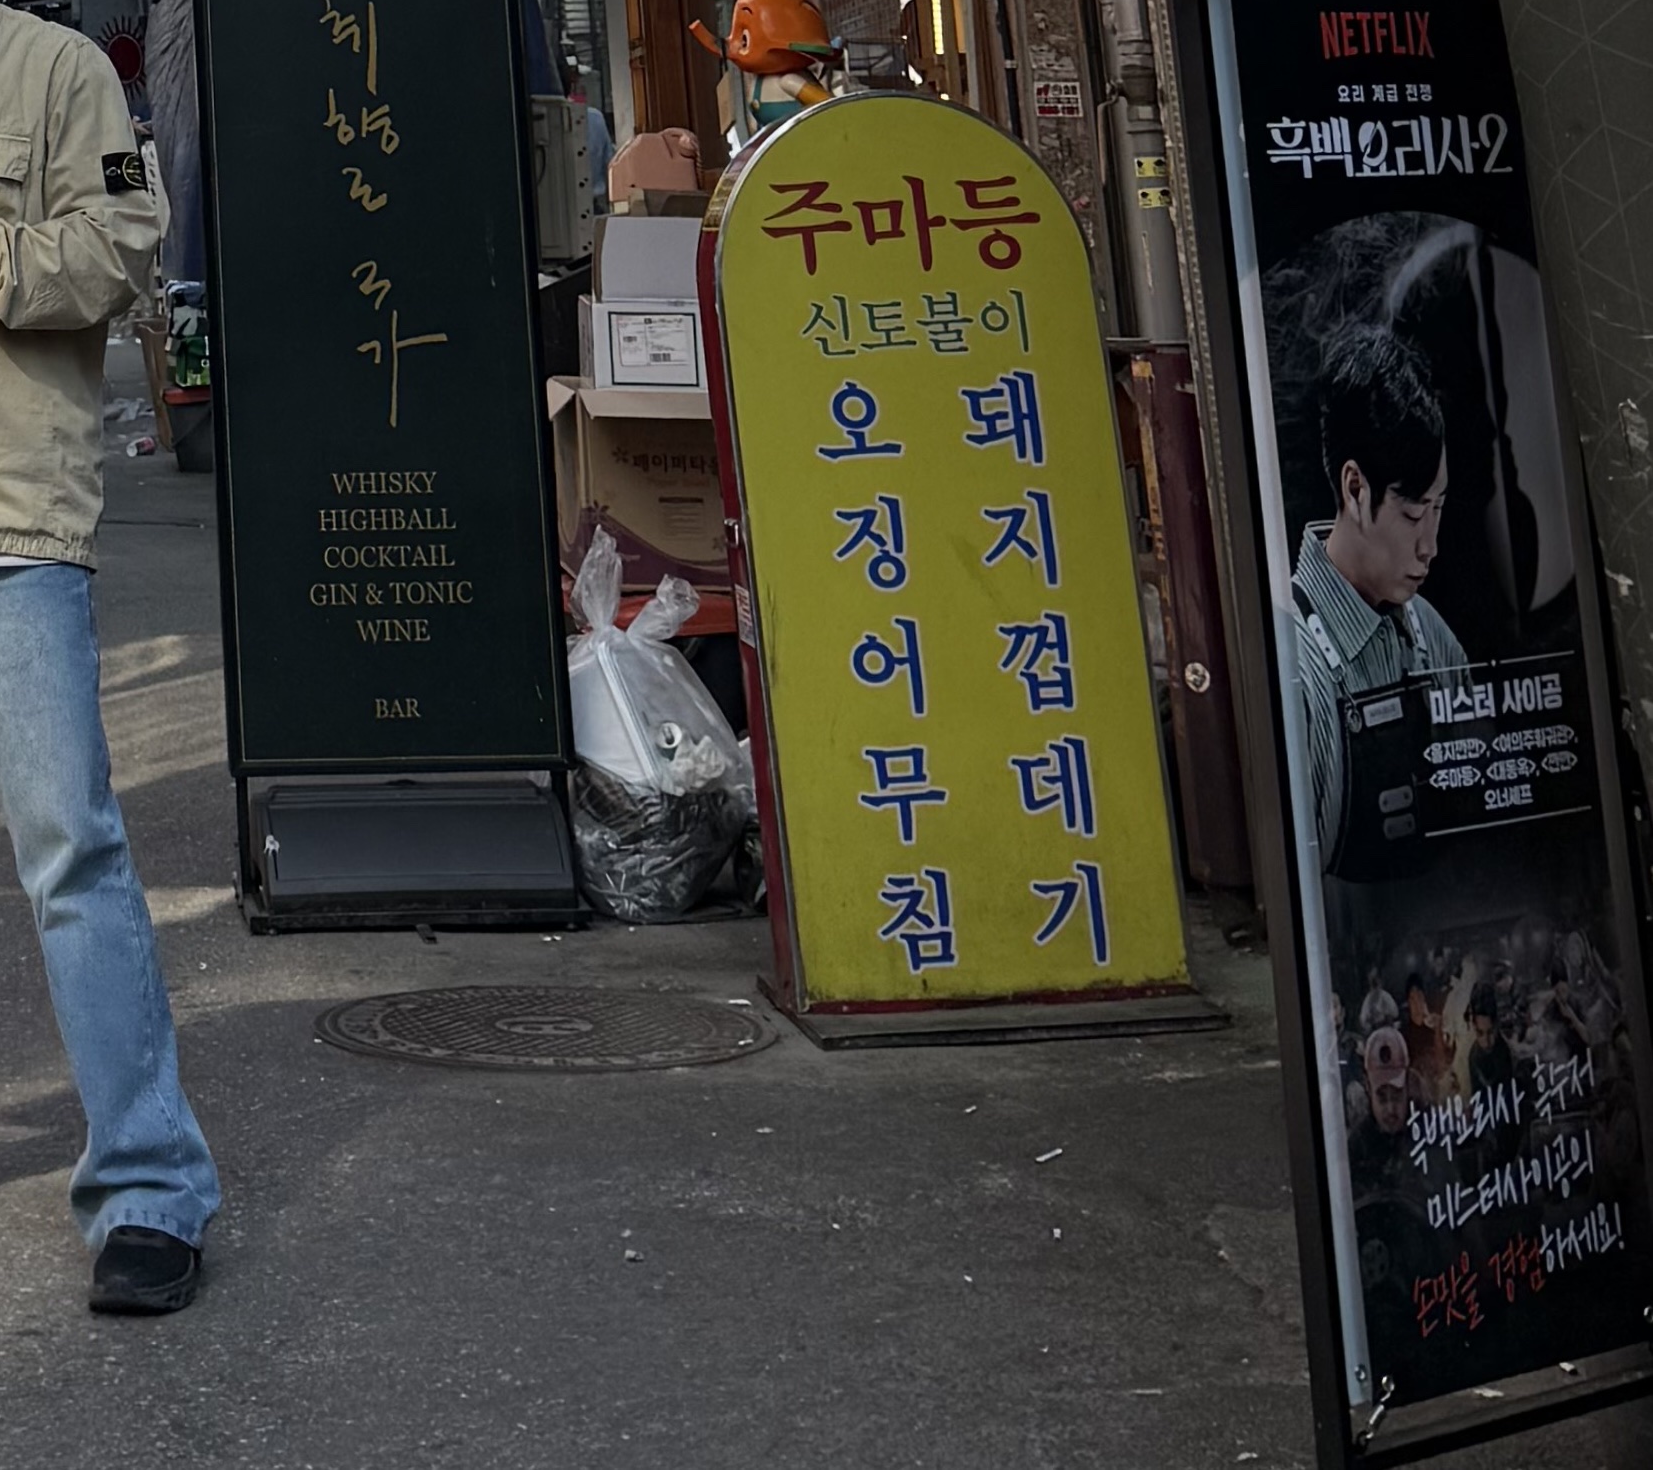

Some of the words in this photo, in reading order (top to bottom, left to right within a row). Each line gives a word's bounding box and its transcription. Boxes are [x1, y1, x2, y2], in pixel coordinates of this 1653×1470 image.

[1319, 10, 1435, 60] NETFLIX
[1337, 83, 1365, 103] 요리
[761, 174, 1041, 276] 주마등
[801, 289, 1030, 357] 신토불이
[332, 472, 437, 494] WHISKY
[319, 508, 457, 531] HIGHBALL
[324, 545, 456, 568] COCKTAIL
[309, 583, 357, 606] GIN
[366, 583, 383, 604] &
[389, 580, 474, 604] TONIC
[356, 618, 432, 643] WINE
[817, 381, 958, 973] 오징어무침
[375, 697, 422, 719] BAR
[1429, 682, 1497, 725] 미스터
[1502, 672, 1564, 715] 사이공
